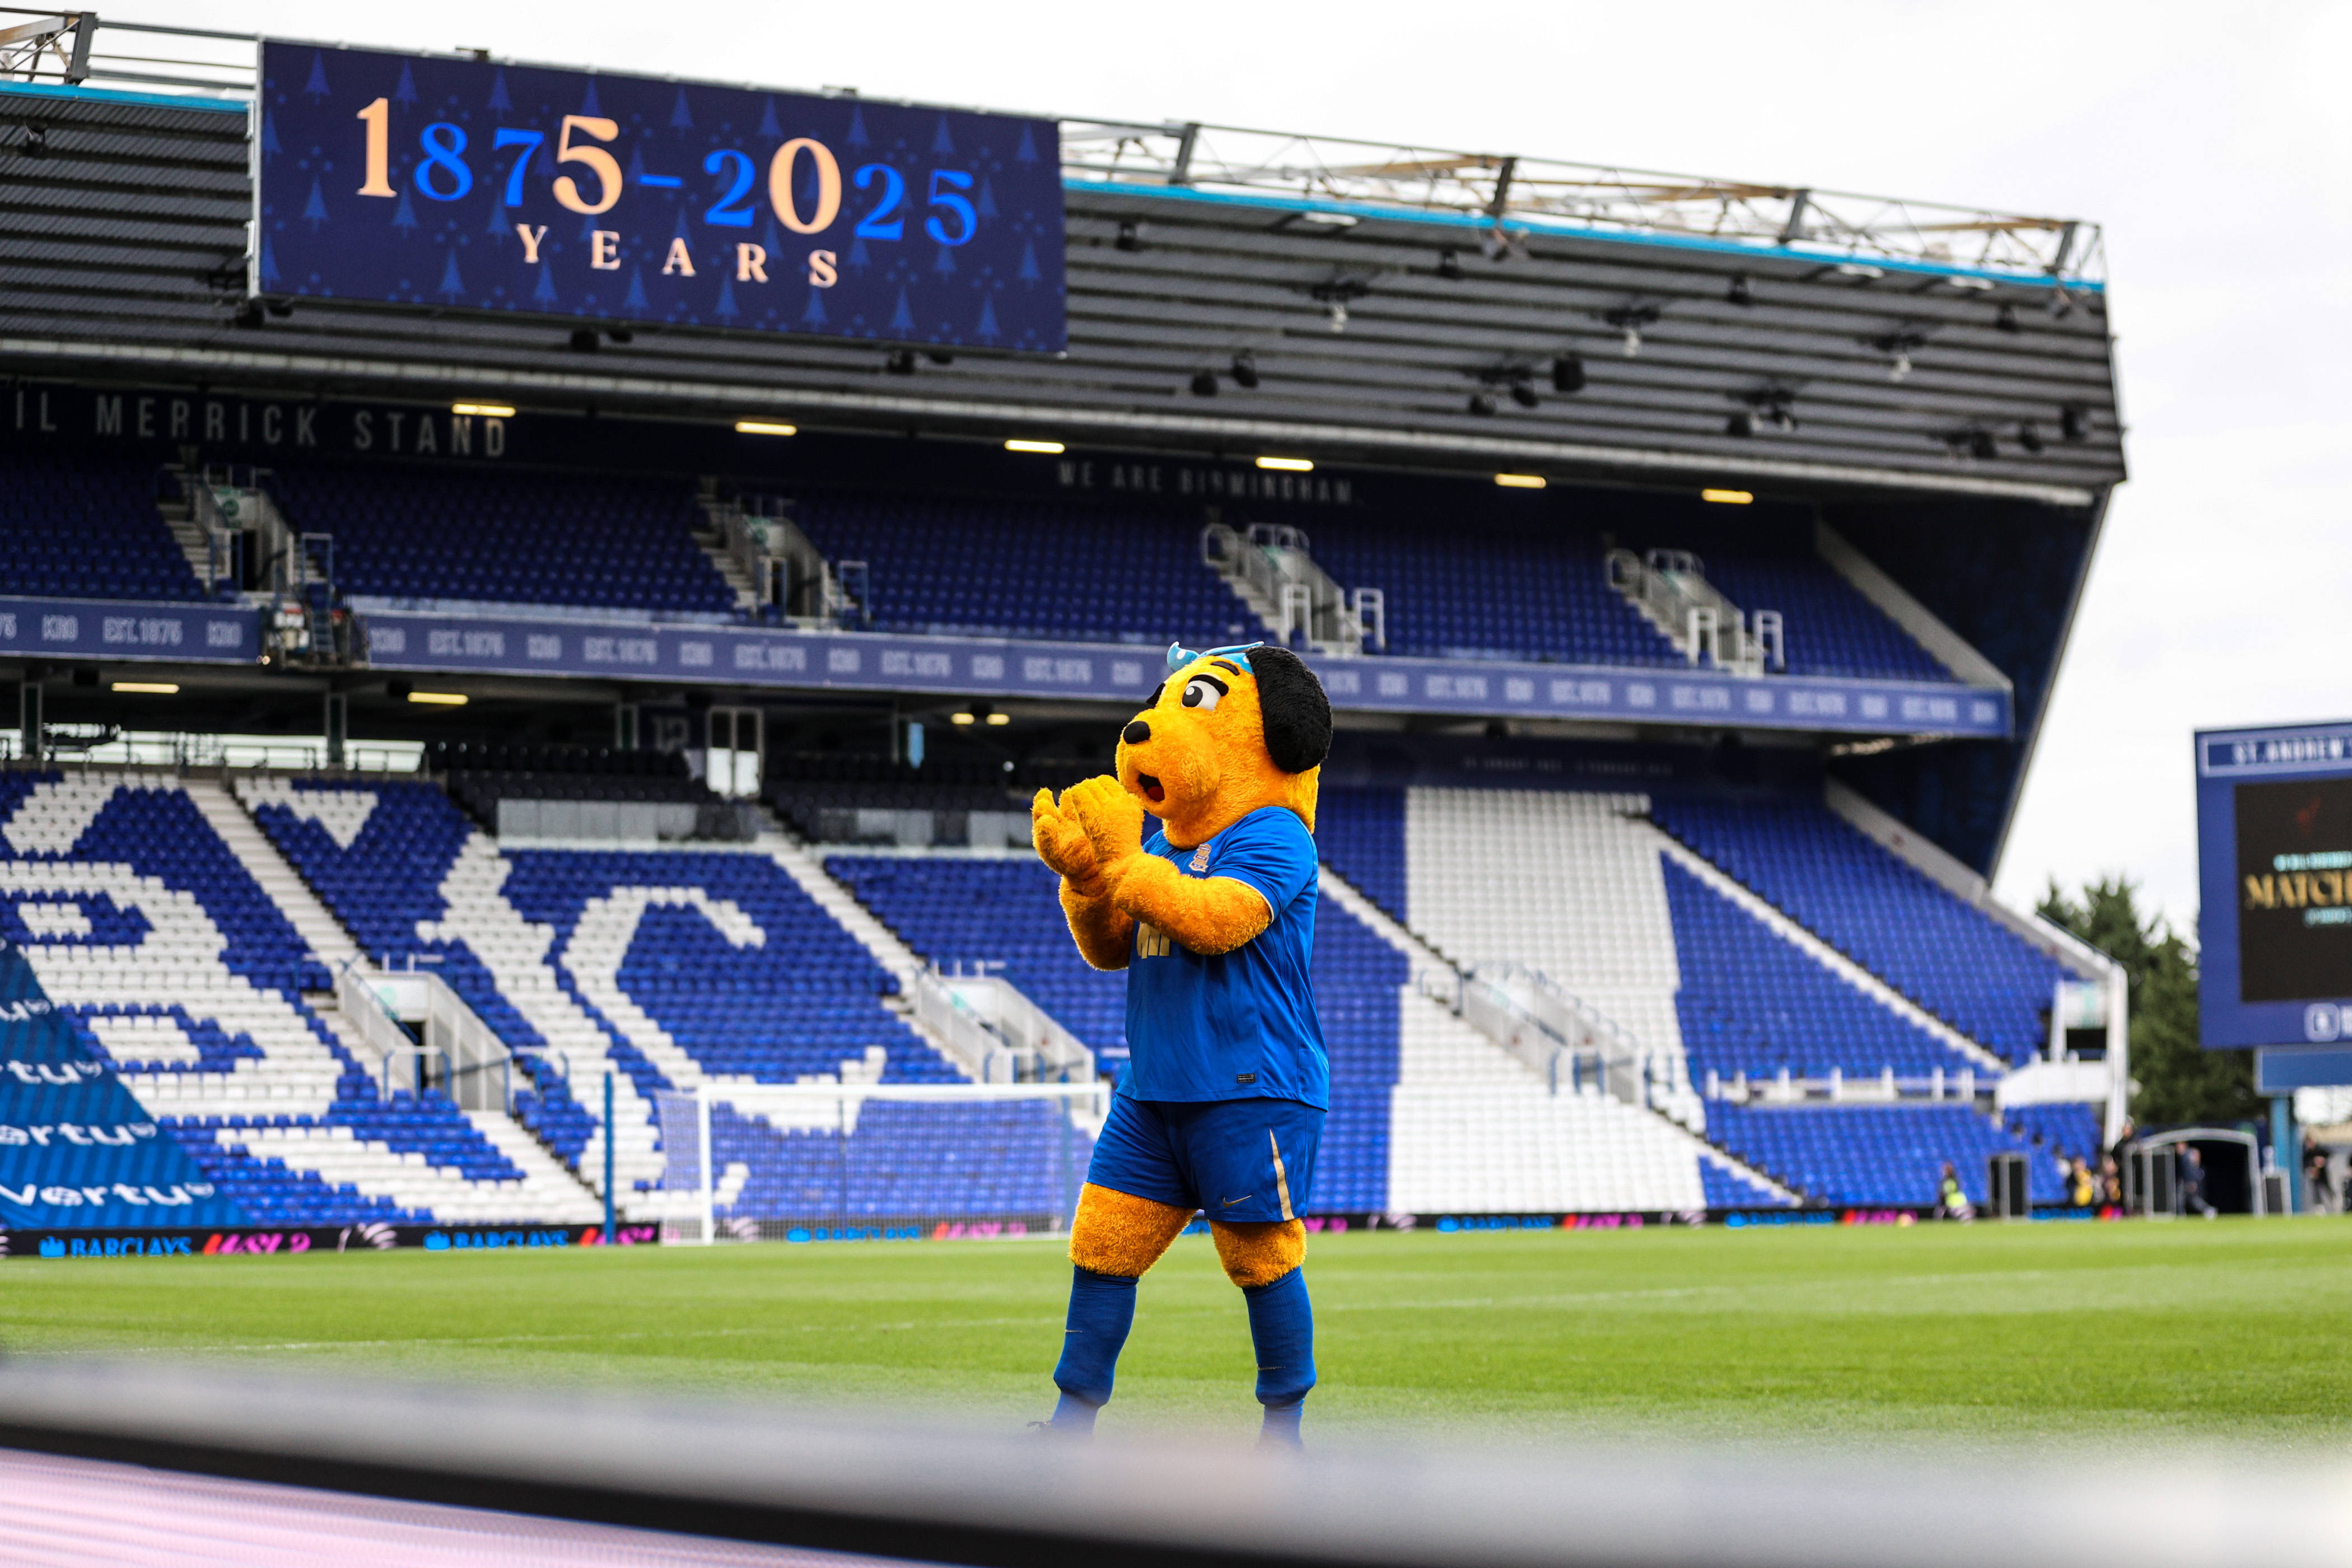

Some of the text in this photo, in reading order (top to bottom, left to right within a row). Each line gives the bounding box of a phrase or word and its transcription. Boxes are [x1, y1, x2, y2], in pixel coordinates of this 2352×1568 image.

[516, 223, 838, 288] YEARS
[96, 394, 317, 446] MERRICK
[353, 411, 506, 458] STAND
[71, 1236, 192, 1257] BARCLAYS
